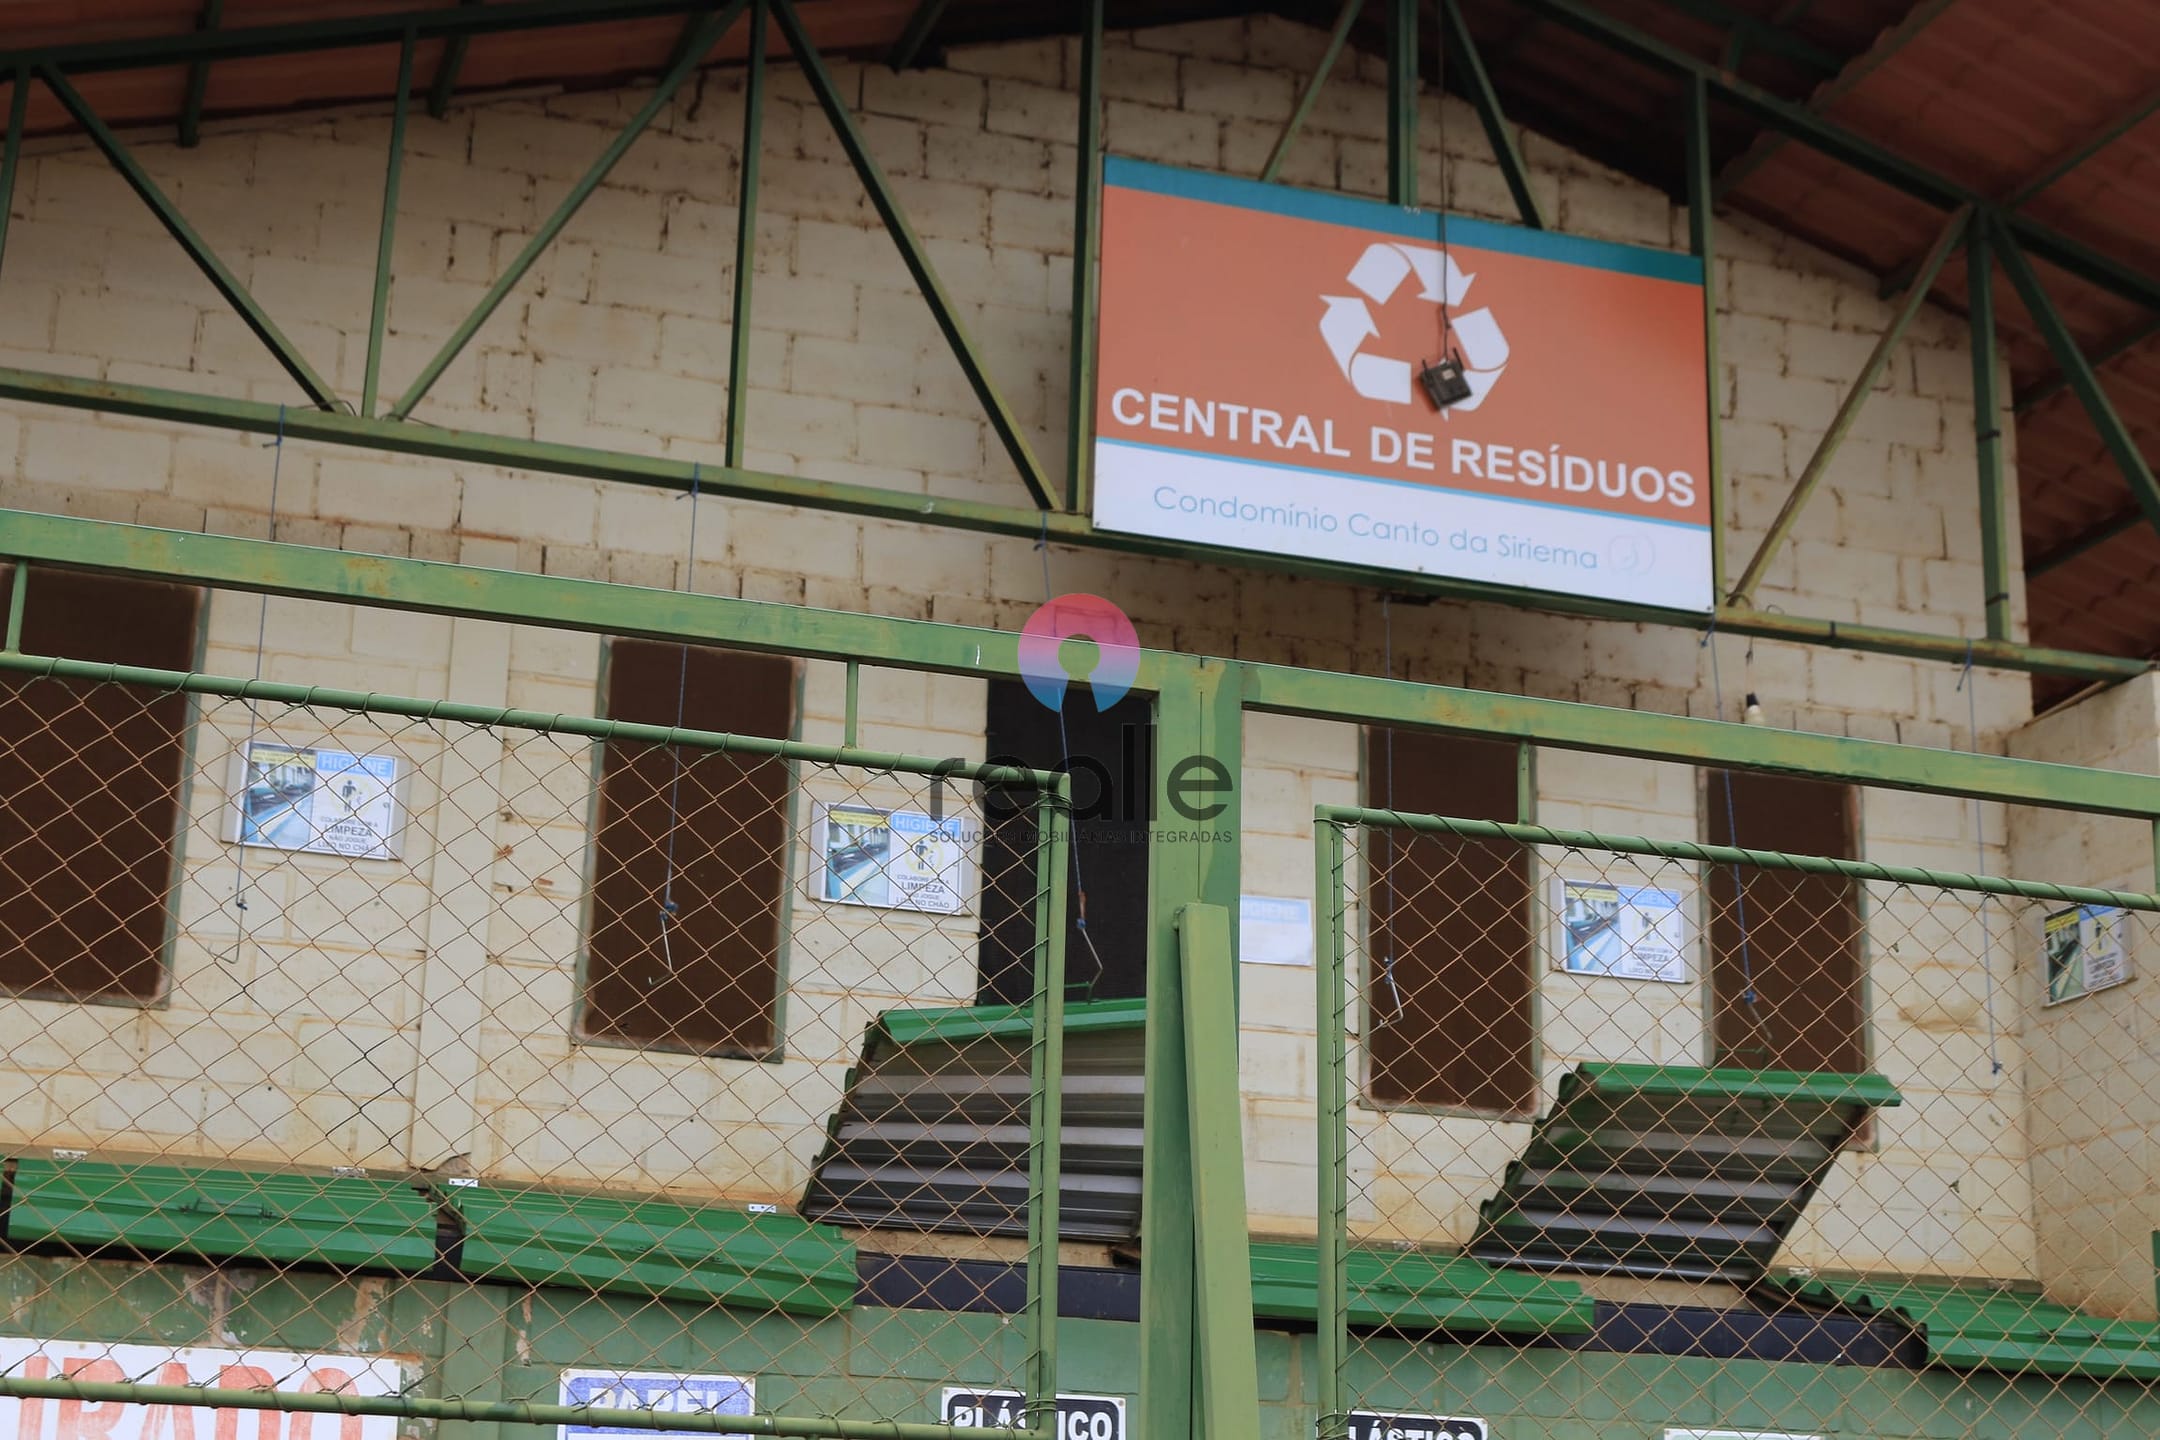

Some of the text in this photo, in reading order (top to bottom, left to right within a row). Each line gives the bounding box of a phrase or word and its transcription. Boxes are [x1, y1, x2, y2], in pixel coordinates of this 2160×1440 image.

[1111, 387, 1696, 507] CENTRAL DE RESÍDUOS
[1153, 486, 1598, 570] Condomínio Canto da Siriema
[322, 754, 388, 776] HIGNE
[895, 814, 954, 832] HIGIEE
[953, 1400, 1113, 1440] PLÁICO
